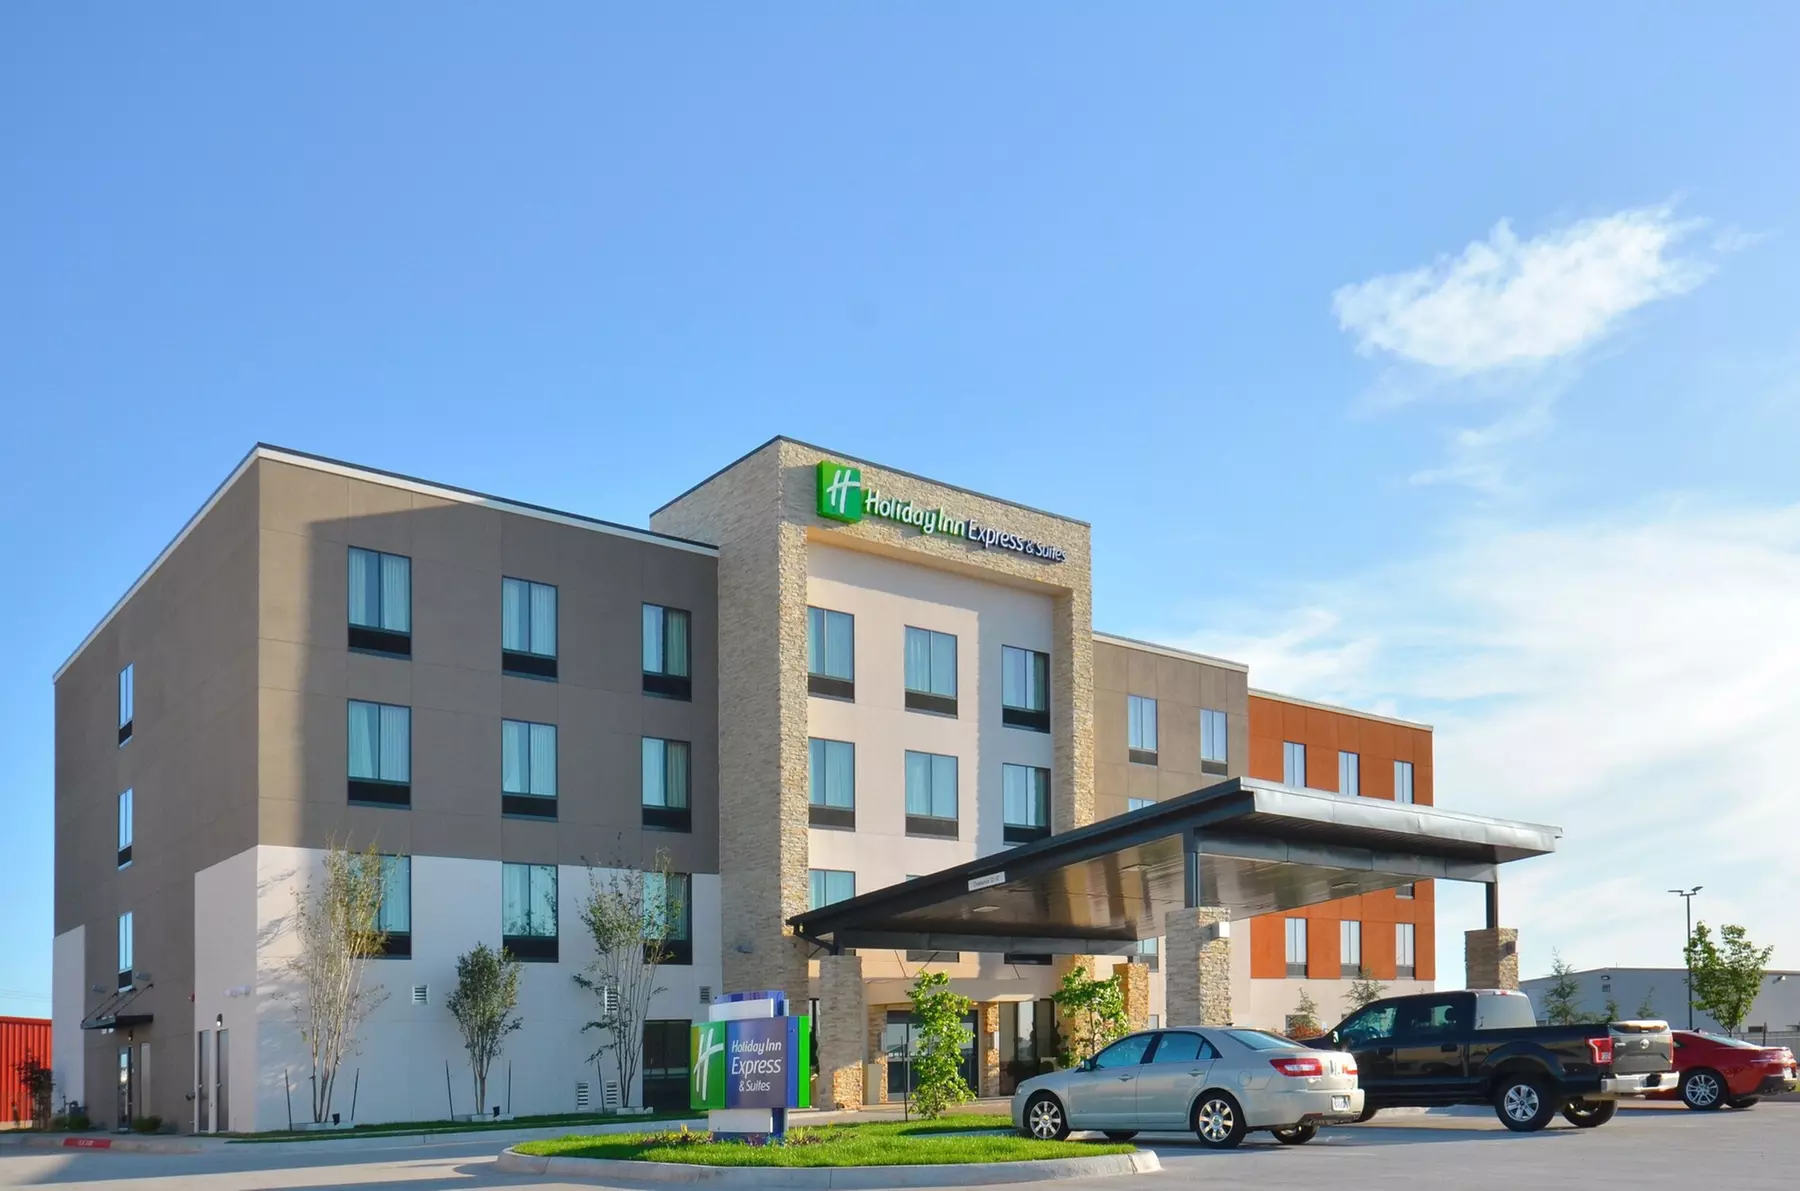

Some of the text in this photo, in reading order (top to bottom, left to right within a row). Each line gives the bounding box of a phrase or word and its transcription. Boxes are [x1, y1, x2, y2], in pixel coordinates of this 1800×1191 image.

[865, 487, 1067, 562] Holiday Inn Express & Suites
[731, 1038, 782, 1055] Holiday Inn
[731, 1057, 782, 1079] Express
[738, 1080, 771, 1092] & Suites
